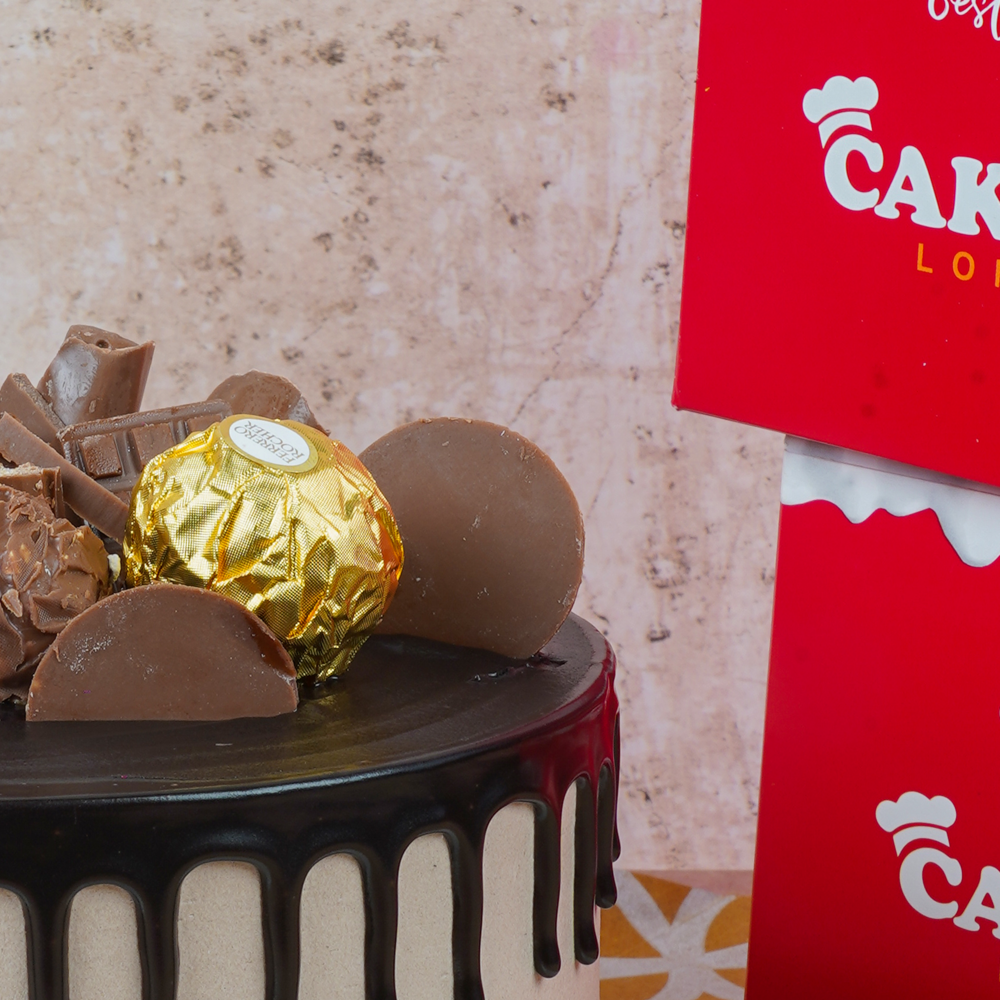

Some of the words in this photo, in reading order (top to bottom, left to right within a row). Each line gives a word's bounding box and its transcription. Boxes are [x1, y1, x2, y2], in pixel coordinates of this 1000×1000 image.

[917, 243, 1000, 287] LO
[234, 426, 294, 464] FERRERO
[244, 421, 305, 459] ROCHER
